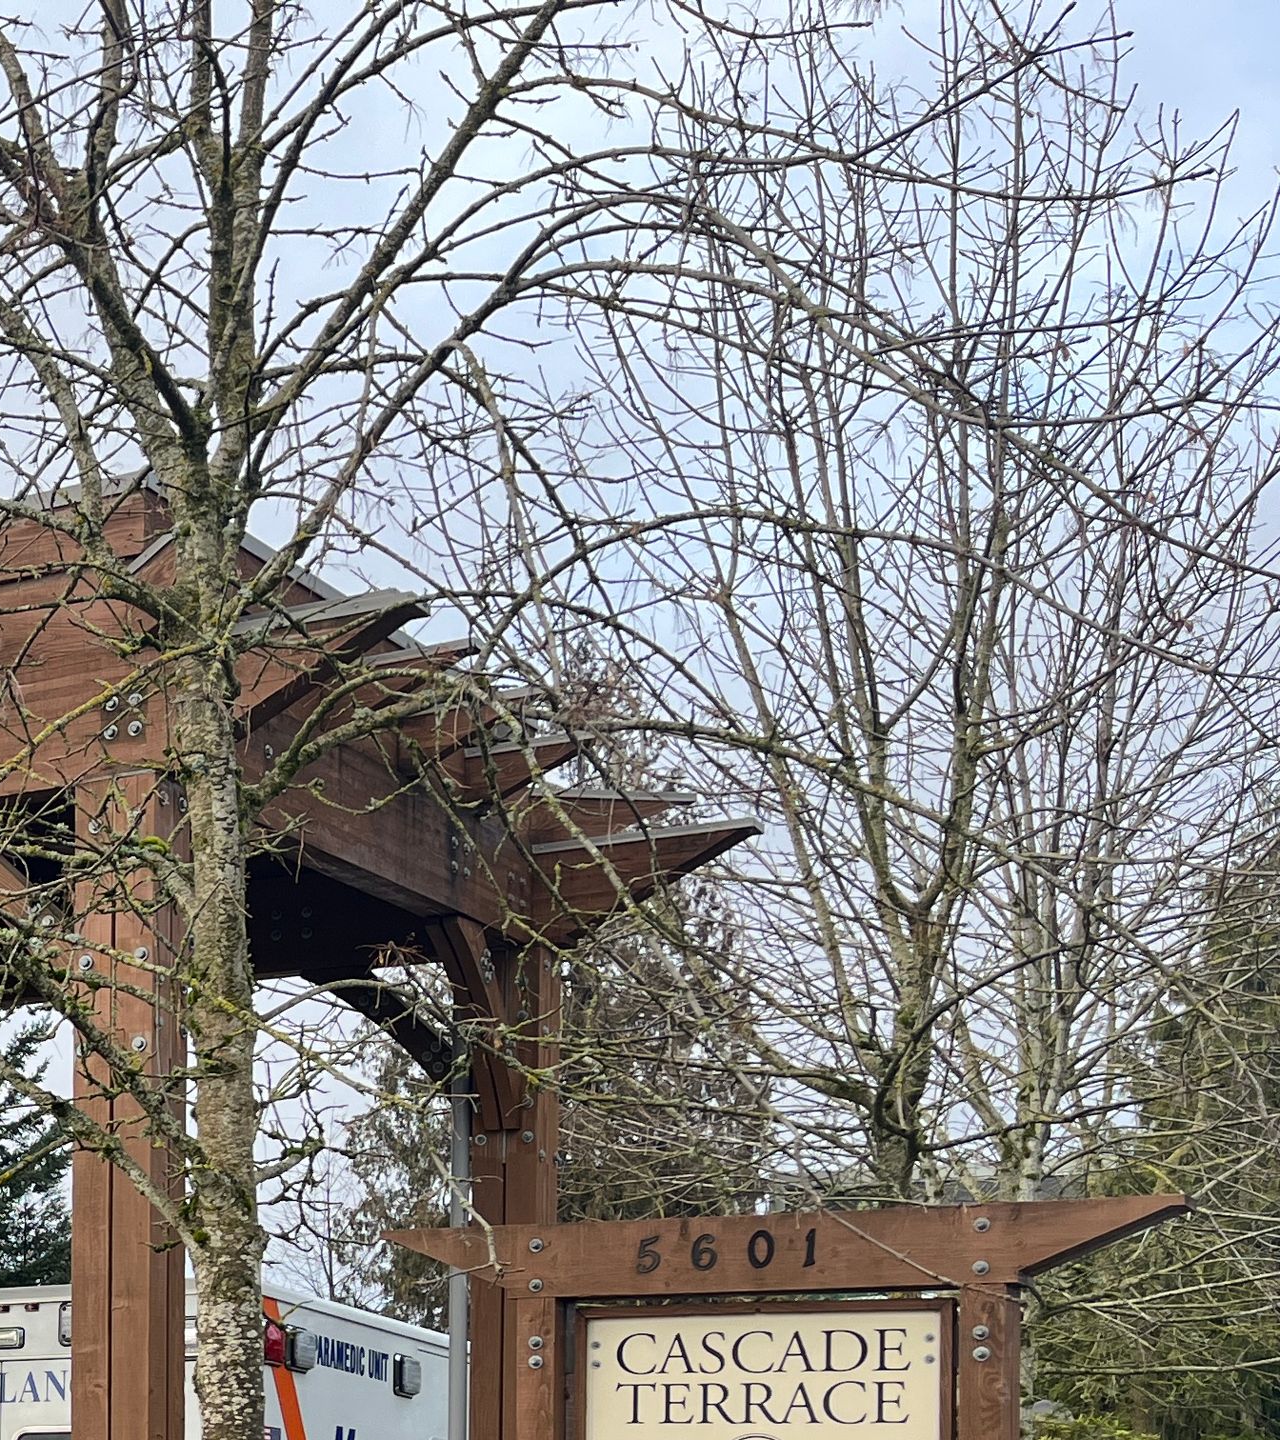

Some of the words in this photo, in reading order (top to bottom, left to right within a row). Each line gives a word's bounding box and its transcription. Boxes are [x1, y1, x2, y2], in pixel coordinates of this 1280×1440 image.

[635, 1228, 817, 1274] 5601
[368, 1348, 389, 1382] UNIT
[616, 1328, 911, 1375] CASCADE
[616, 1380, 910, 1425] TERRACE
